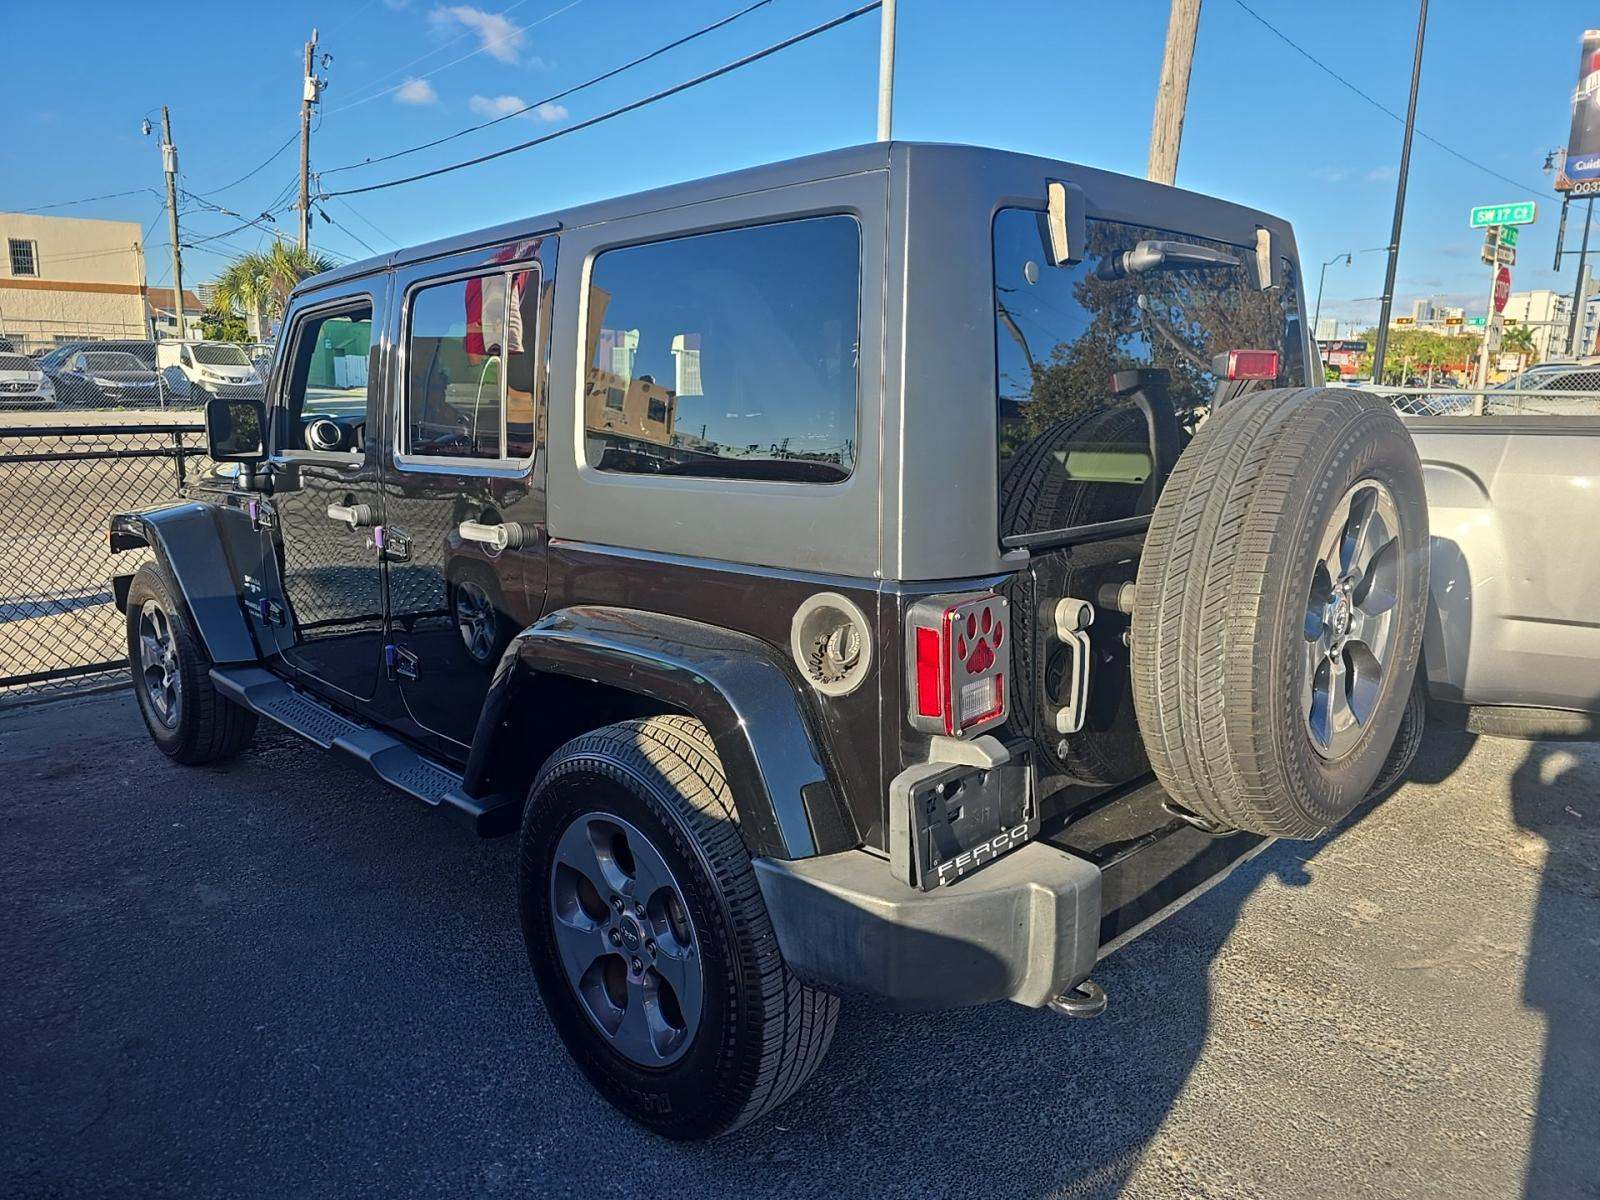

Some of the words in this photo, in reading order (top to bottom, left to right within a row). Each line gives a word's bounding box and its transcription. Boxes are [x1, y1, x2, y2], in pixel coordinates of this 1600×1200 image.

[1477, 209, 1495, 223] SW
[1497, 208, 1511, 222] 17
[1496, 280, 1510, 299] STOP
[937, 824, 1028, 878] FERCO
[939, 833, 1029, 886] MOTORS
